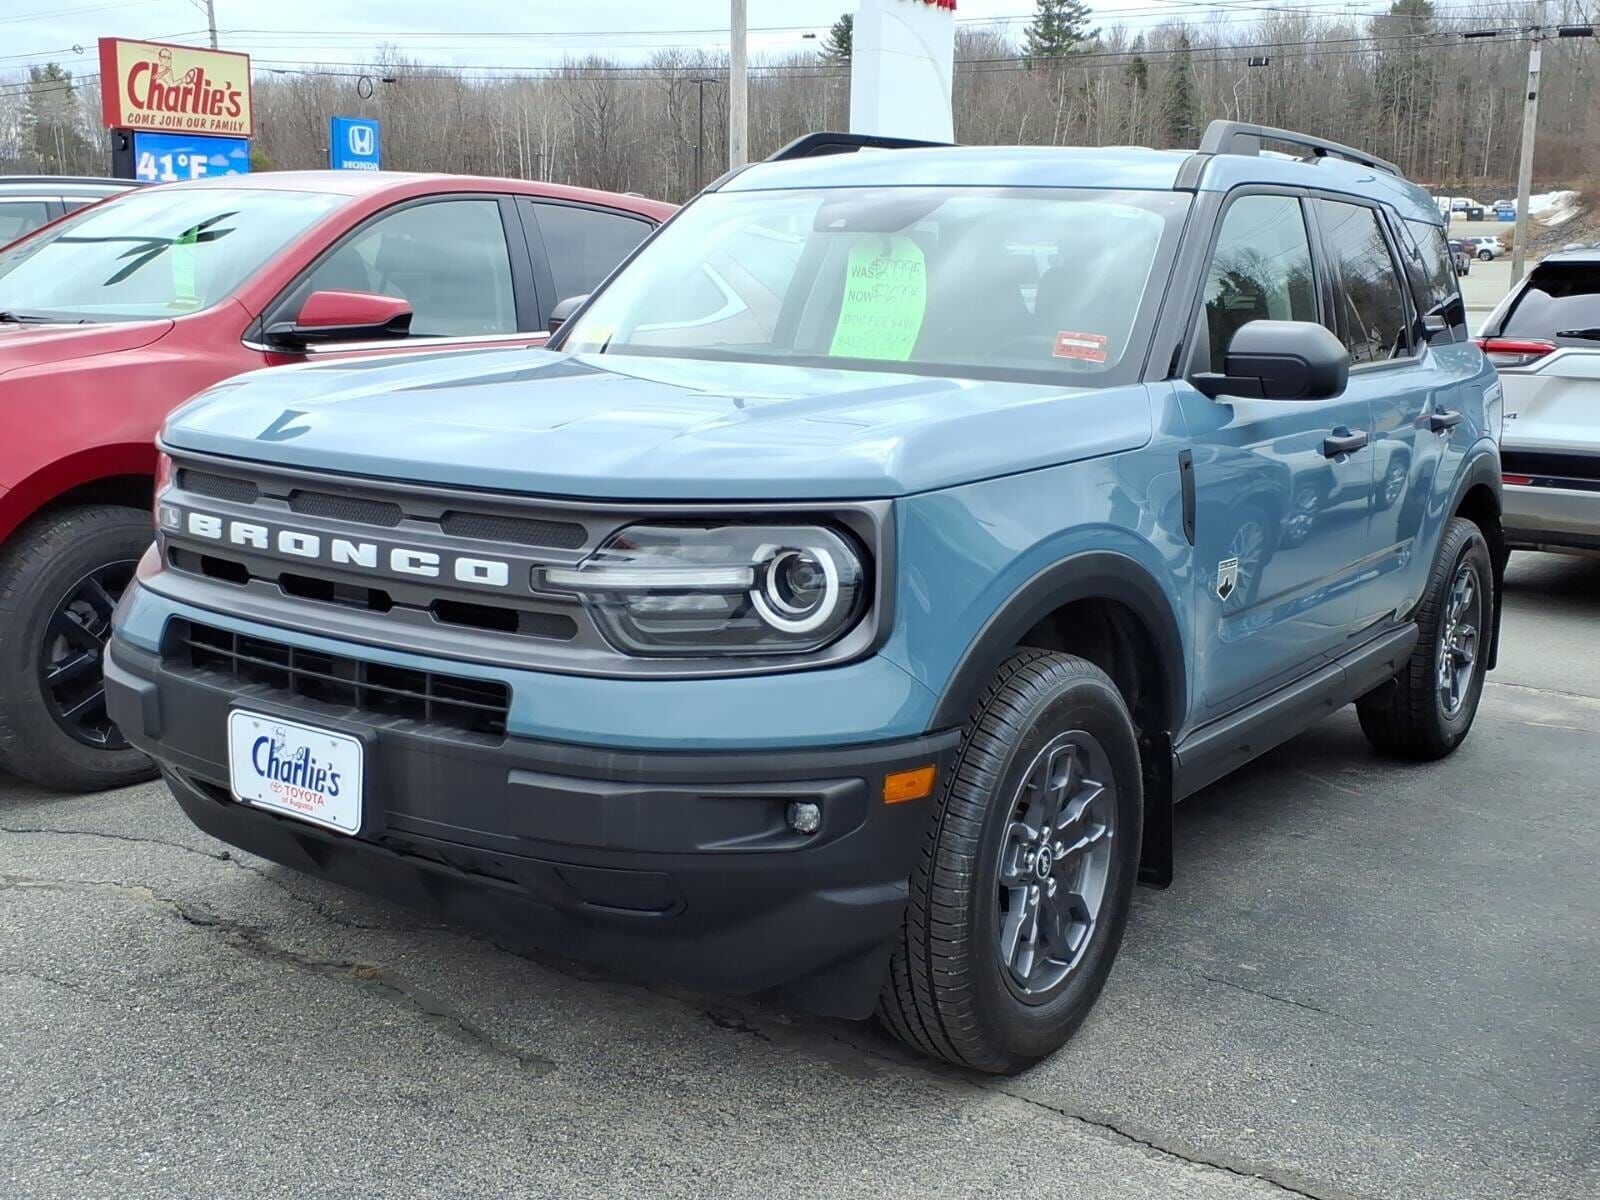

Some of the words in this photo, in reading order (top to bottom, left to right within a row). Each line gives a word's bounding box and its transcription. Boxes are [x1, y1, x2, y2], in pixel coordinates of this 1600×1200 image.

[127, 61, 242, 118] Charlie's
[127, 112, 156, 126] COME
[159, 115, 183, 128] JOIN
[186, 117, 206, 129] OUR
[210, 119, 245, 132] FAMILY
[138, 151, 208, 181] 41°F
[851, 264, 874, 279] WAS
[847, 290, 873, 303] NOW
[187, 512, 509, 587] BRONCO
[252, 735, 341, 797] Charlie's
[284, 785, 325, 806] TOYOTA
